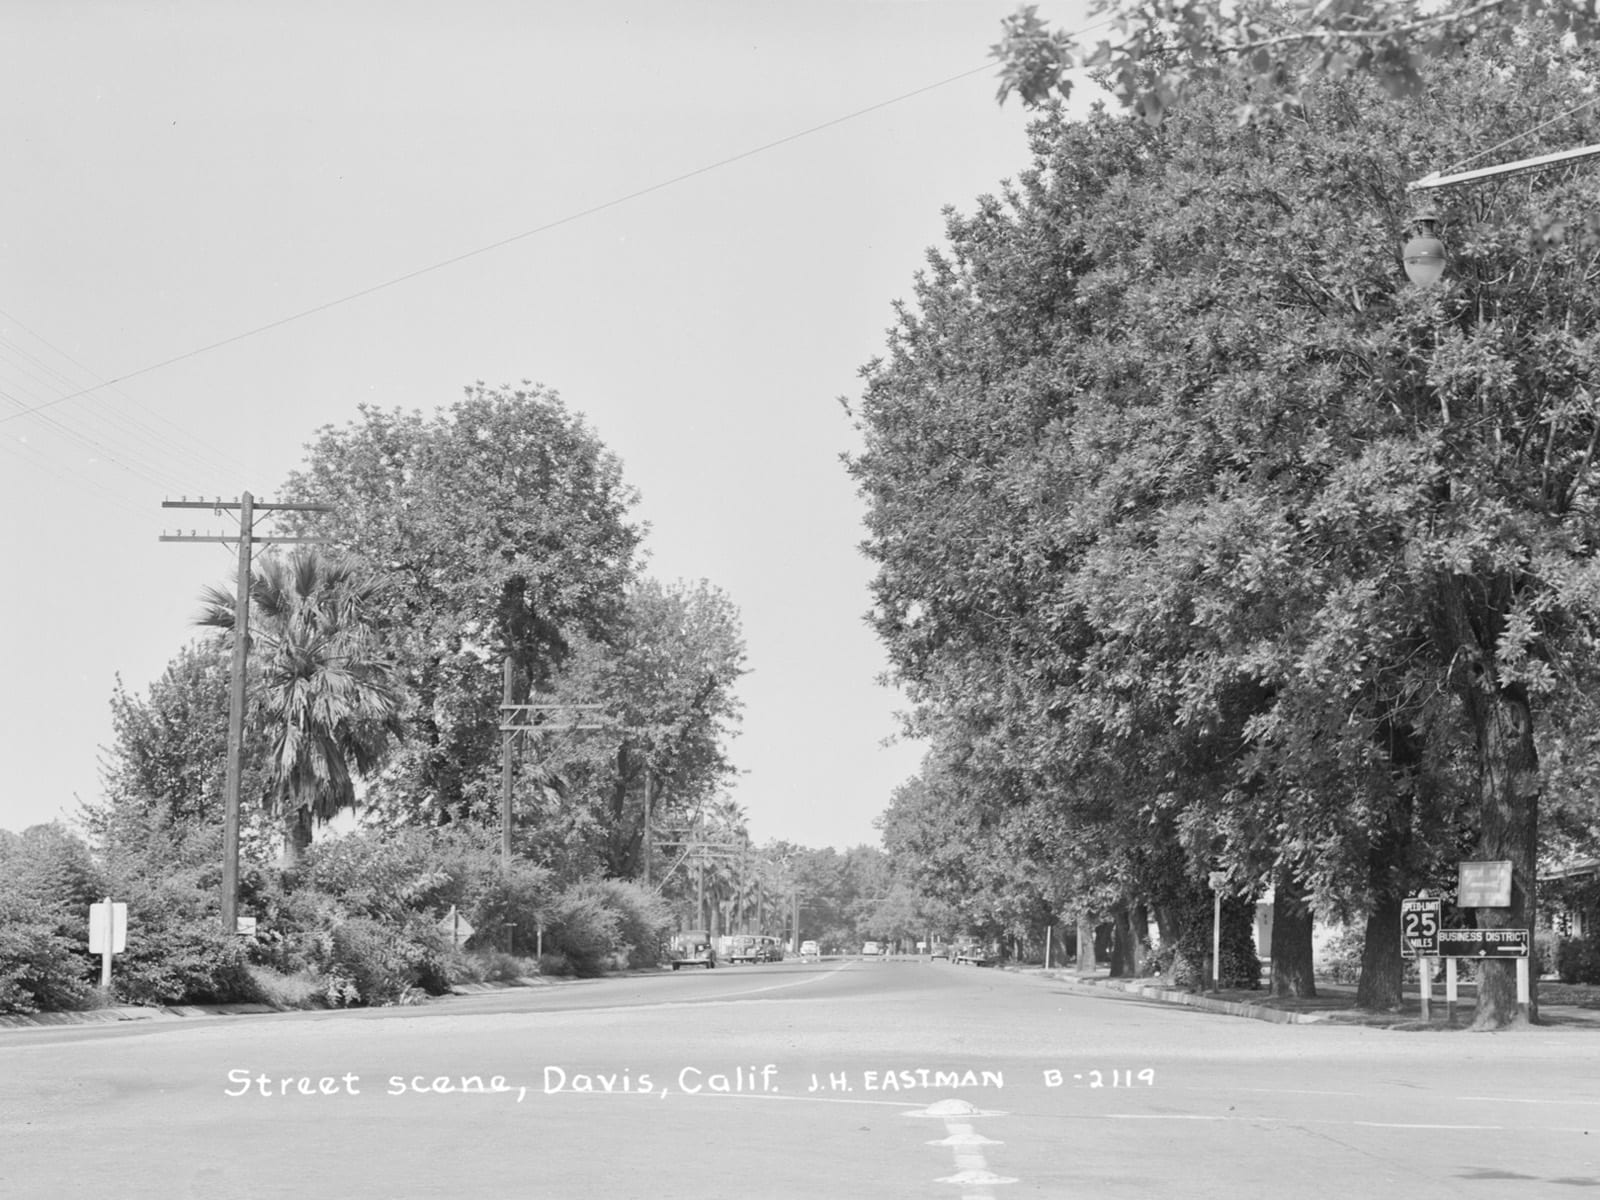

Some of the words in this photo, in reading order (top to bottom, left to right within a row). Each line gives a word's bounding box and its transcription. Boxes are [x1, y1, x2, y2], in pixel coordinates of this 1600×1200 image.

[1402, 902, 1421, 912] SPEED
[1422, 901, 1439, 911] LIMIT
[1406, 913, 1436, 937] 25
[1439, 932, 1483, 942] BUSINESS
[1486, 932, 1527, 942] DISTRICT
[1411, 938, 1432, 947] MILES
